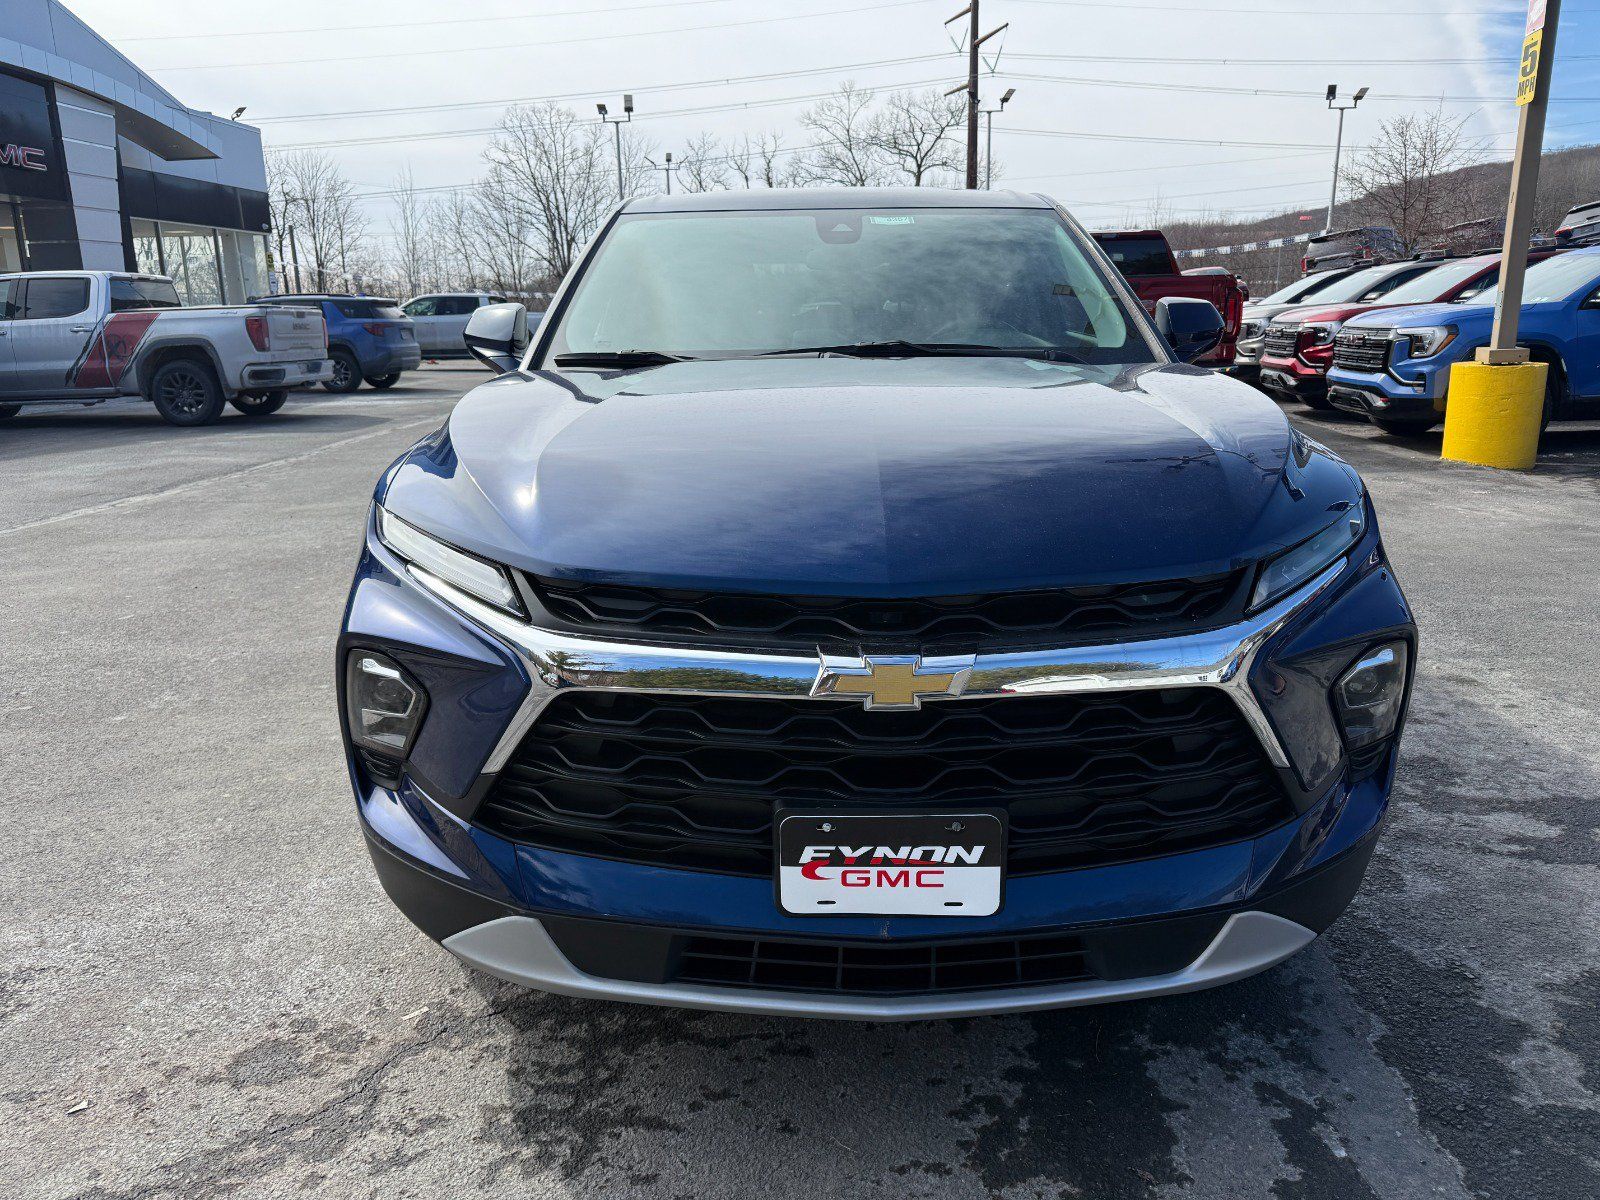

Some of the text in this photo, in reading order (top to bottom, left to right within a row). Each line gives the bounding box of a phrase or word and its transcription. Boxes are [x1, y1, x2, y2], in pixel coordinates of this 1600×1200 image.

[1521, 40, 1539, 77] 5
[1517, 76, 1536, 97] MPH
[840, 869, 945, 888] GMC
